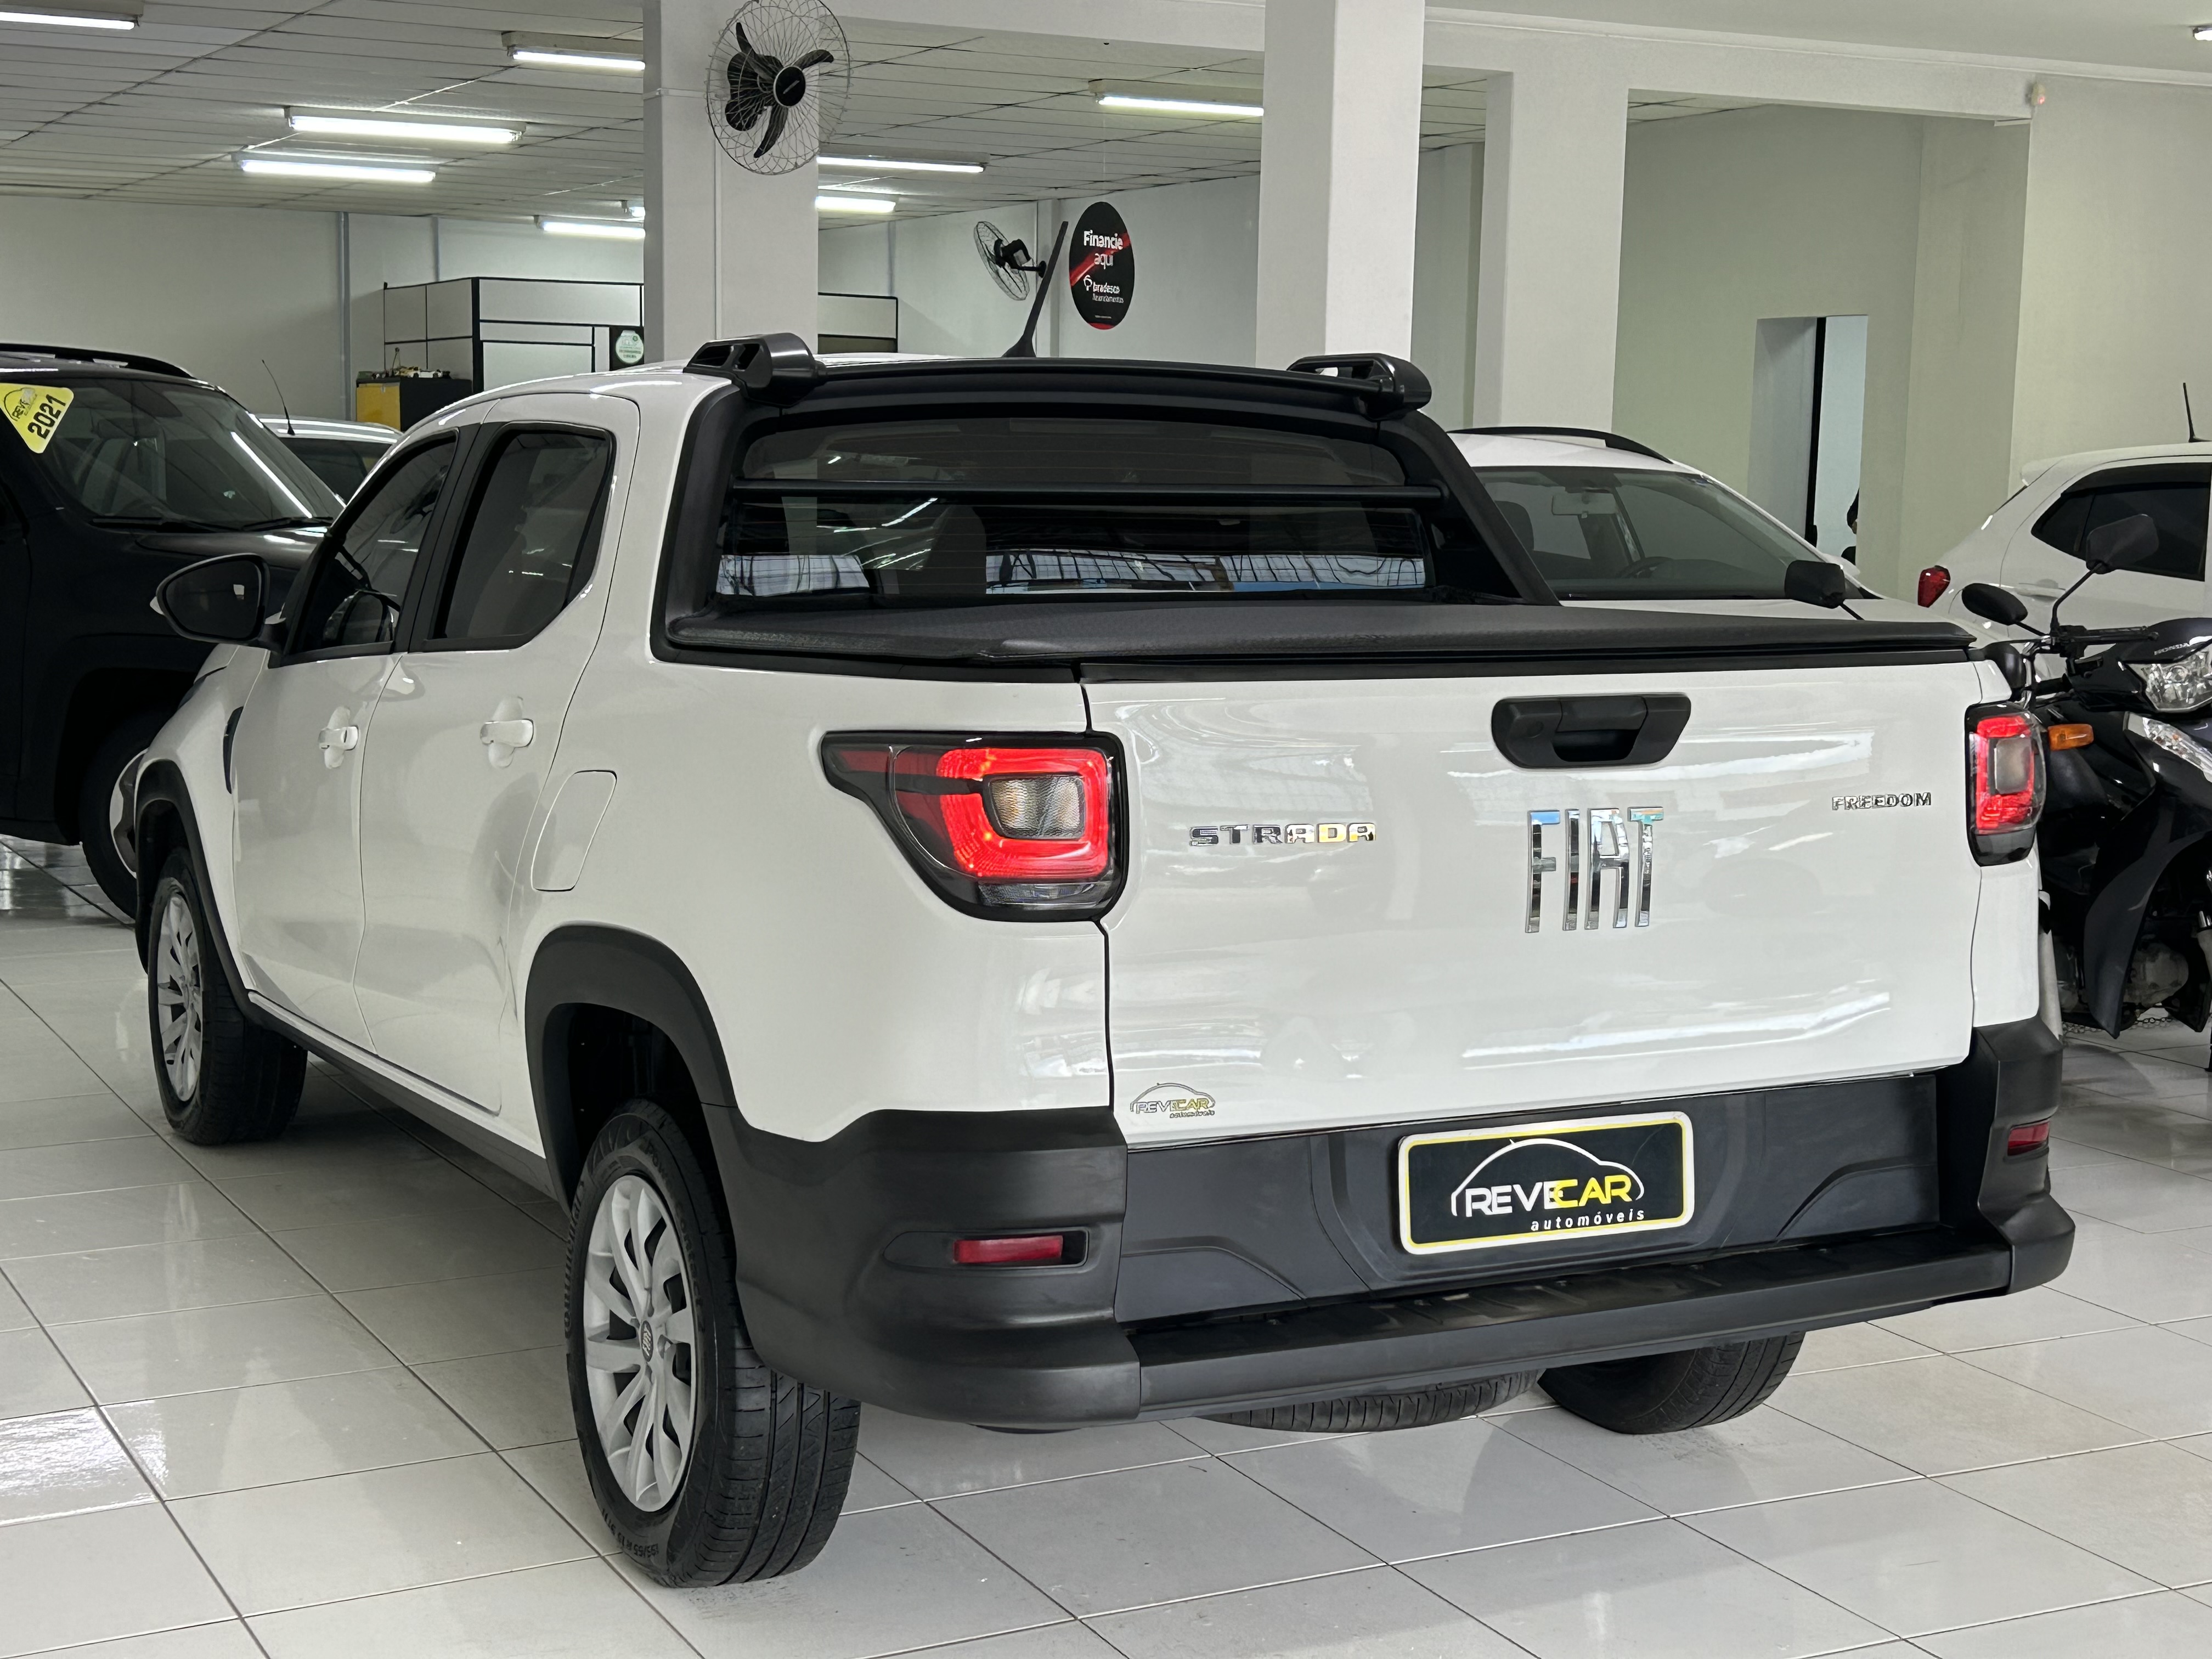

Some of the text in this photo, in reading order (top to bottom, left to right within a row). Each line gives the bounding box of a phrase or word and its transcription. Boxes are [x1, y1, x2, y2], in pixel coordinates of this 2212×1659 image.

[1084, 230, 1124, 250] Financie
[1094, 251, 1114, 269] aqui
[27, 394, 66, 439] 2021
[1832, 792, 1931, 810] FREEDOM
[1189, 823, 1375, 846] STRADA
[1525, 806, 1664, 933] FIAT
[1465, 1175, 1633, 1217] REVECAR
[1530, 1209, 1645, 1231] automóveis
